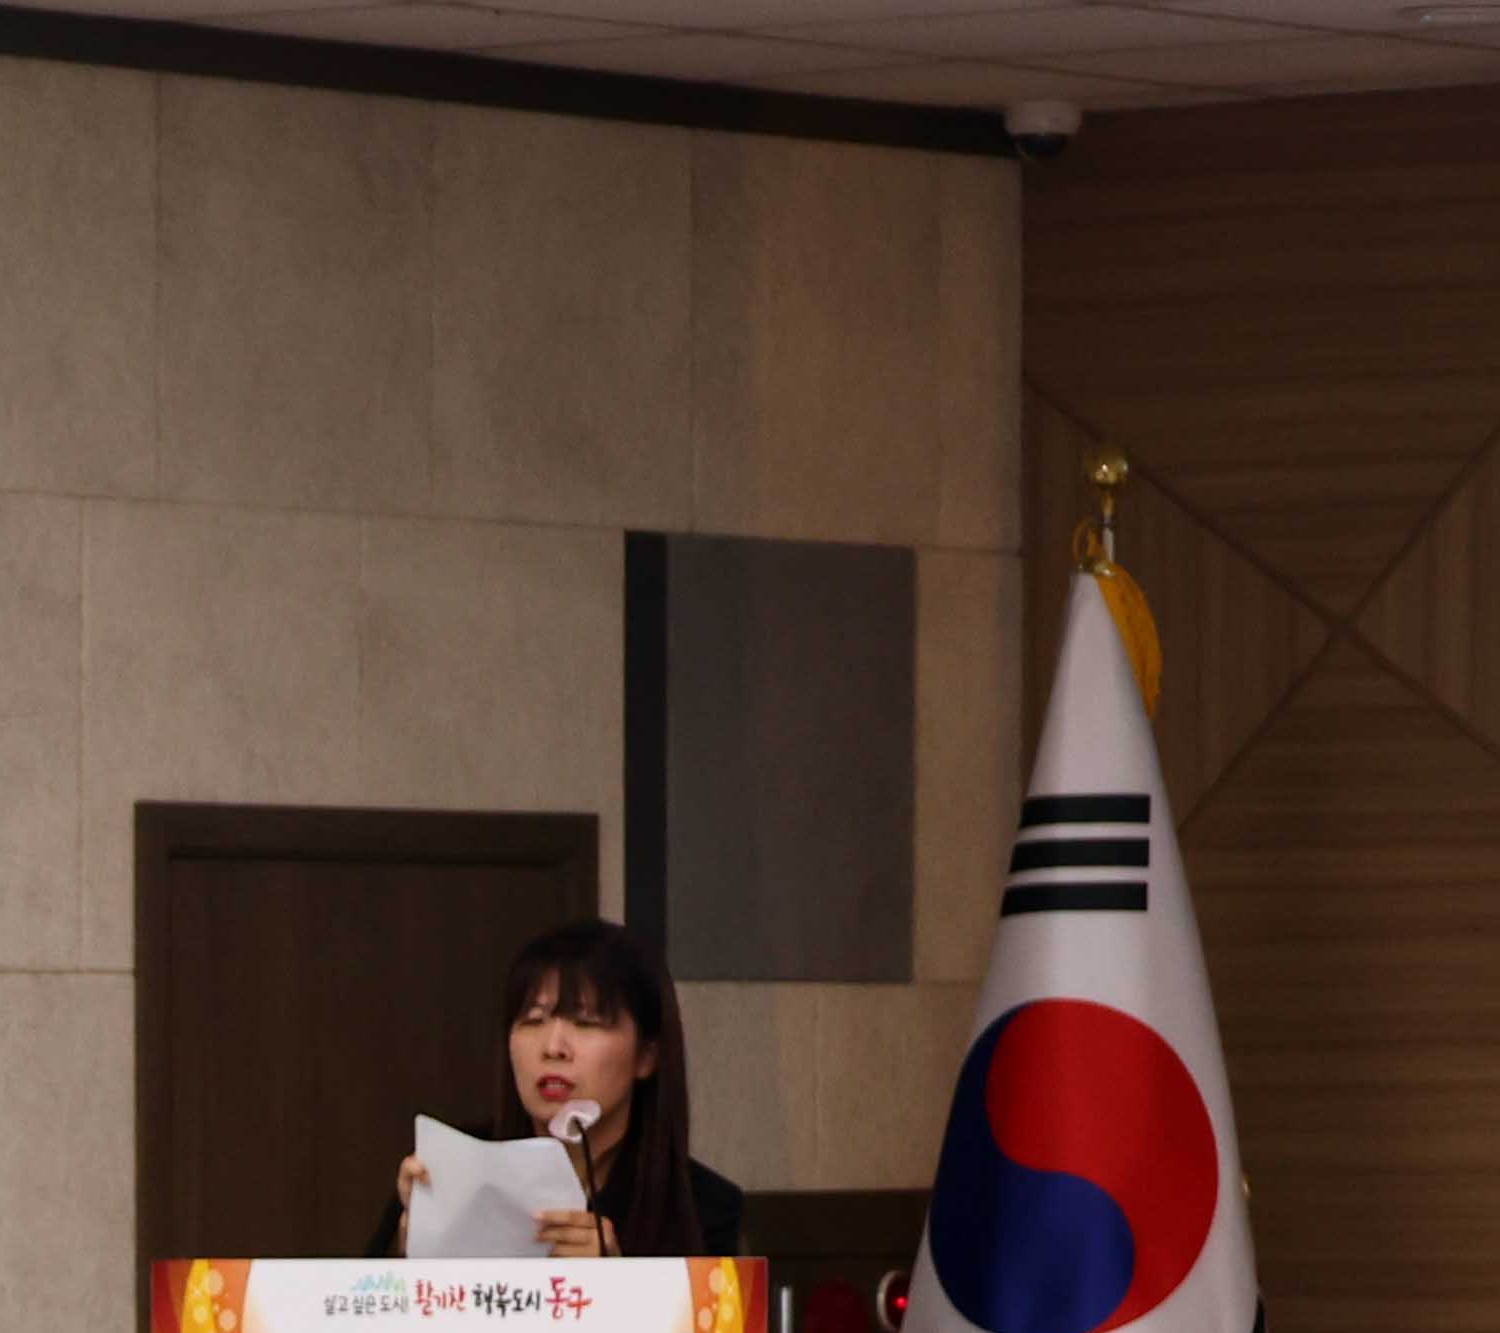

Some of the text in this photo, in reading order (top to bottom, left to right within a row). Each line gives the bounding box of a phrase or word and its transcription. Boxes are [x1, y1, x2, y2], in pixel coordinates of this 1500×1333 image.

[414, 1279, 467, 1317] 활기찬
[472, 1283, 542, 1317] 행복도시
[545, 1276, 594, 1320] 동구
